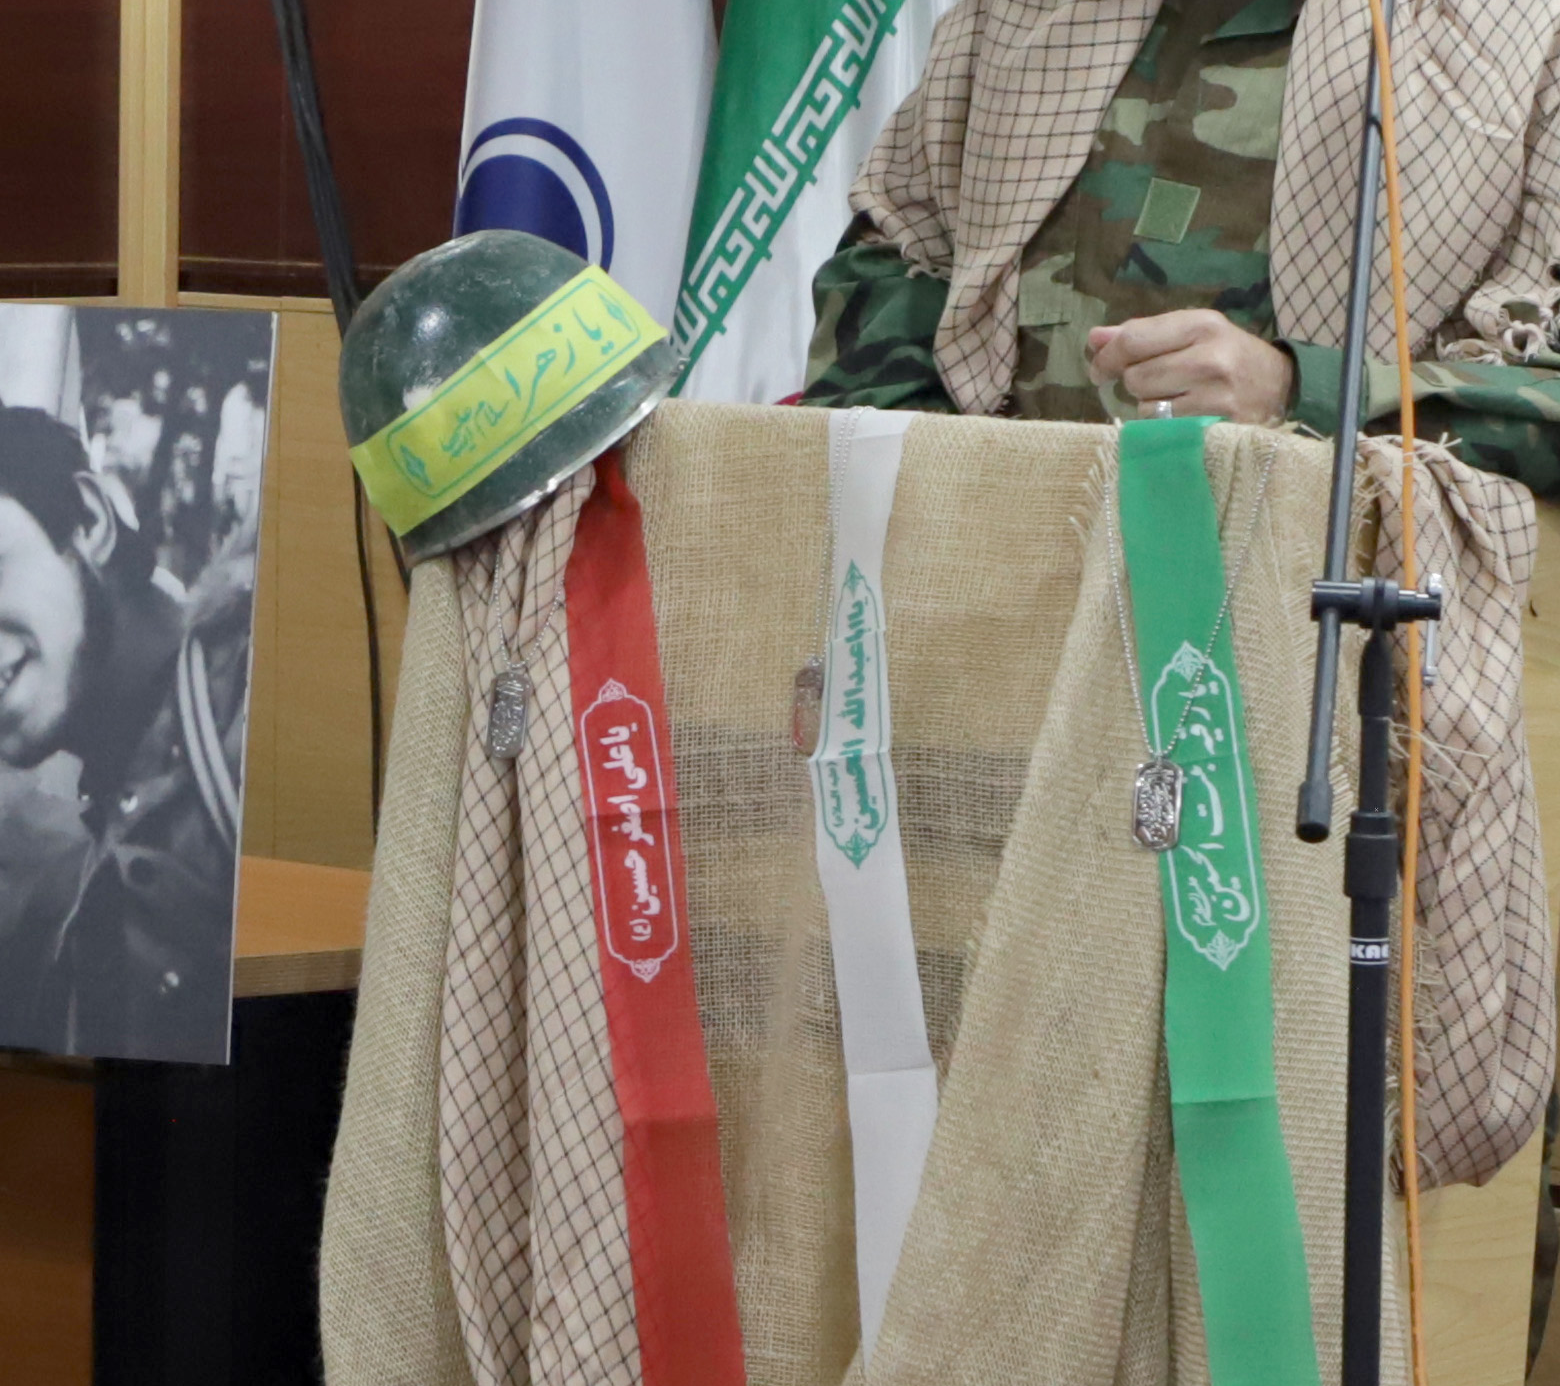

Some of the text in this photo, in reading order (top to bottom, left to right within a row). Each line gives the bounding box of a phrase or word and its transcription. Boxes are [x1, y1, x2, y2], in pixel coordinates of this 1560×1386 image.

[573, 307, 616, 356] یا
[505, 321, 577, 424] زهرا
[599, 722, 638, 747] یا
[602, 747, 648, 791] علی
[607, 794, 655, 847] اصغر
[624, 849, 661, 917] حسین
[1181, 842, 1251, 922] الحسین
